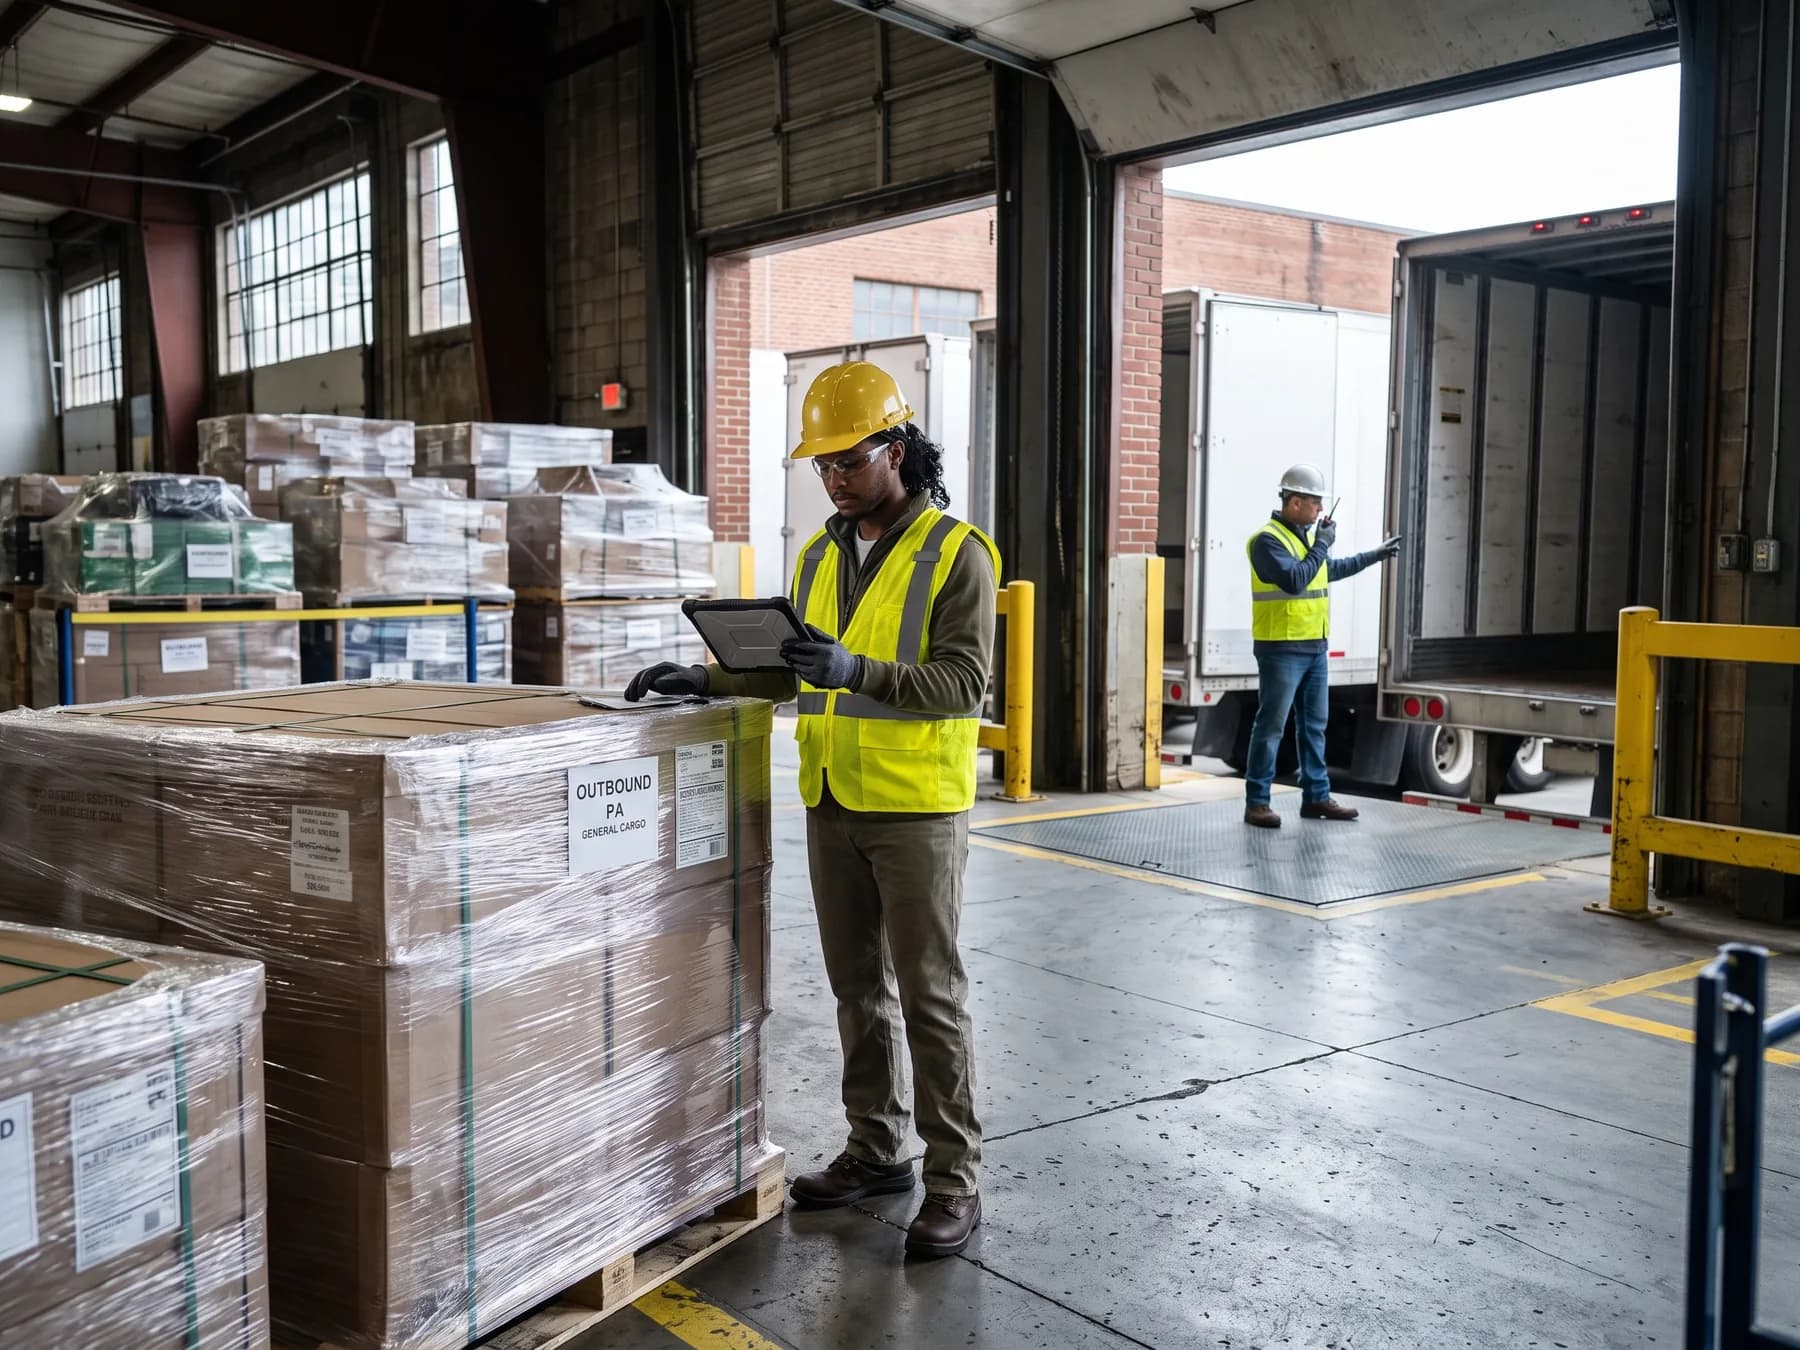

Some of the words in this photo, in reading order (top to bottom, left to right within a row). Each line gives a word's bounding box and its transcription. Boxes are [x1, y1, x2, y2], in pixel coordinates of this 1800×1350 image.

[576, 775, 651, 800] OUTBOUND
[606, 802, 624, 819] PA
[582, 825, 618, 839] GENERAL
[620, 818, 646, 832] CARGO
